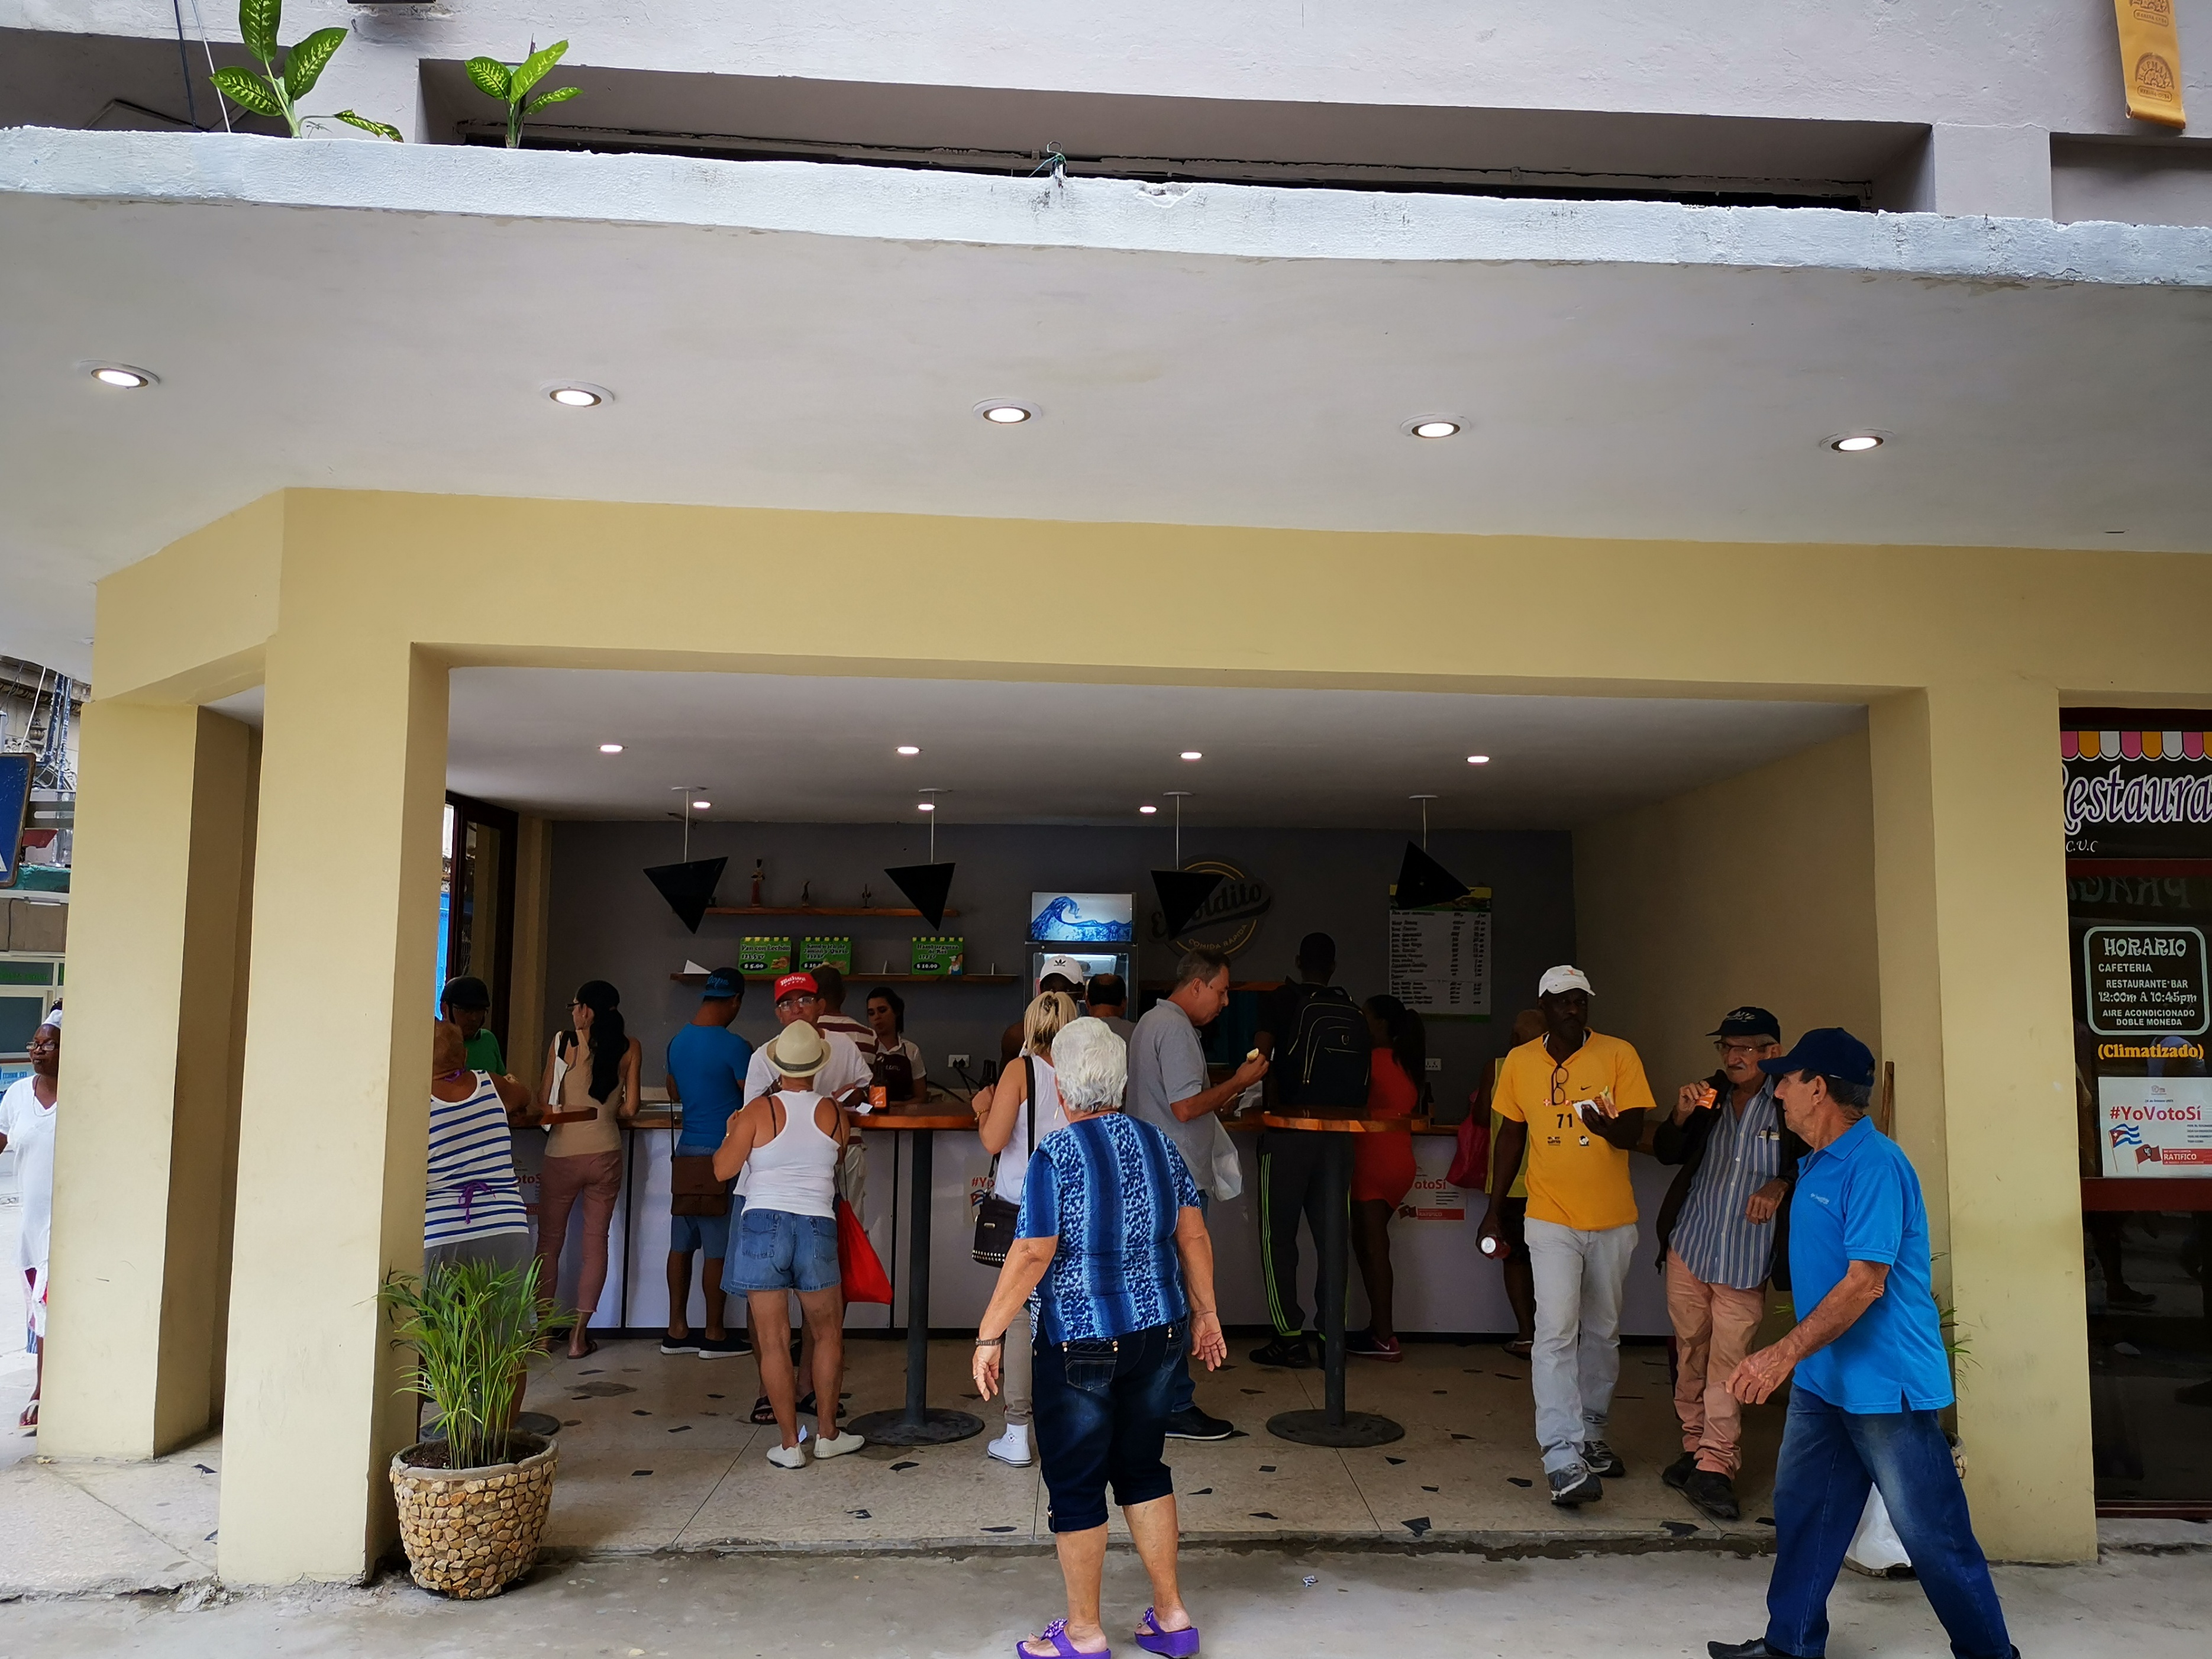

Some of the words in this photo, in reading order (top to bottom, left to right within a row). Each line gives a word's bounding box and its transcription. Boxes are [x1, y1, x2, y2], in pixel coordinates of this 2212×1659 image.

[1189, 938, 1222, 950] COMIDA
[2103, 937, 2187, 957] HORARIO
[2098, 963, 2152, 973] CAFETERIA
[2140, 992, 2148, 1002] A
[2150, 990, 2197, 1004] 10:45pm
[2116, 1018, 2144, 1026] DOBLE
[2146, 1018, 2182, 1026] MONEDA
[2098, 1044, 2204, 1060] (Climatizado)
[2110, 1105, 2201, 1121] #YoVotoSí
